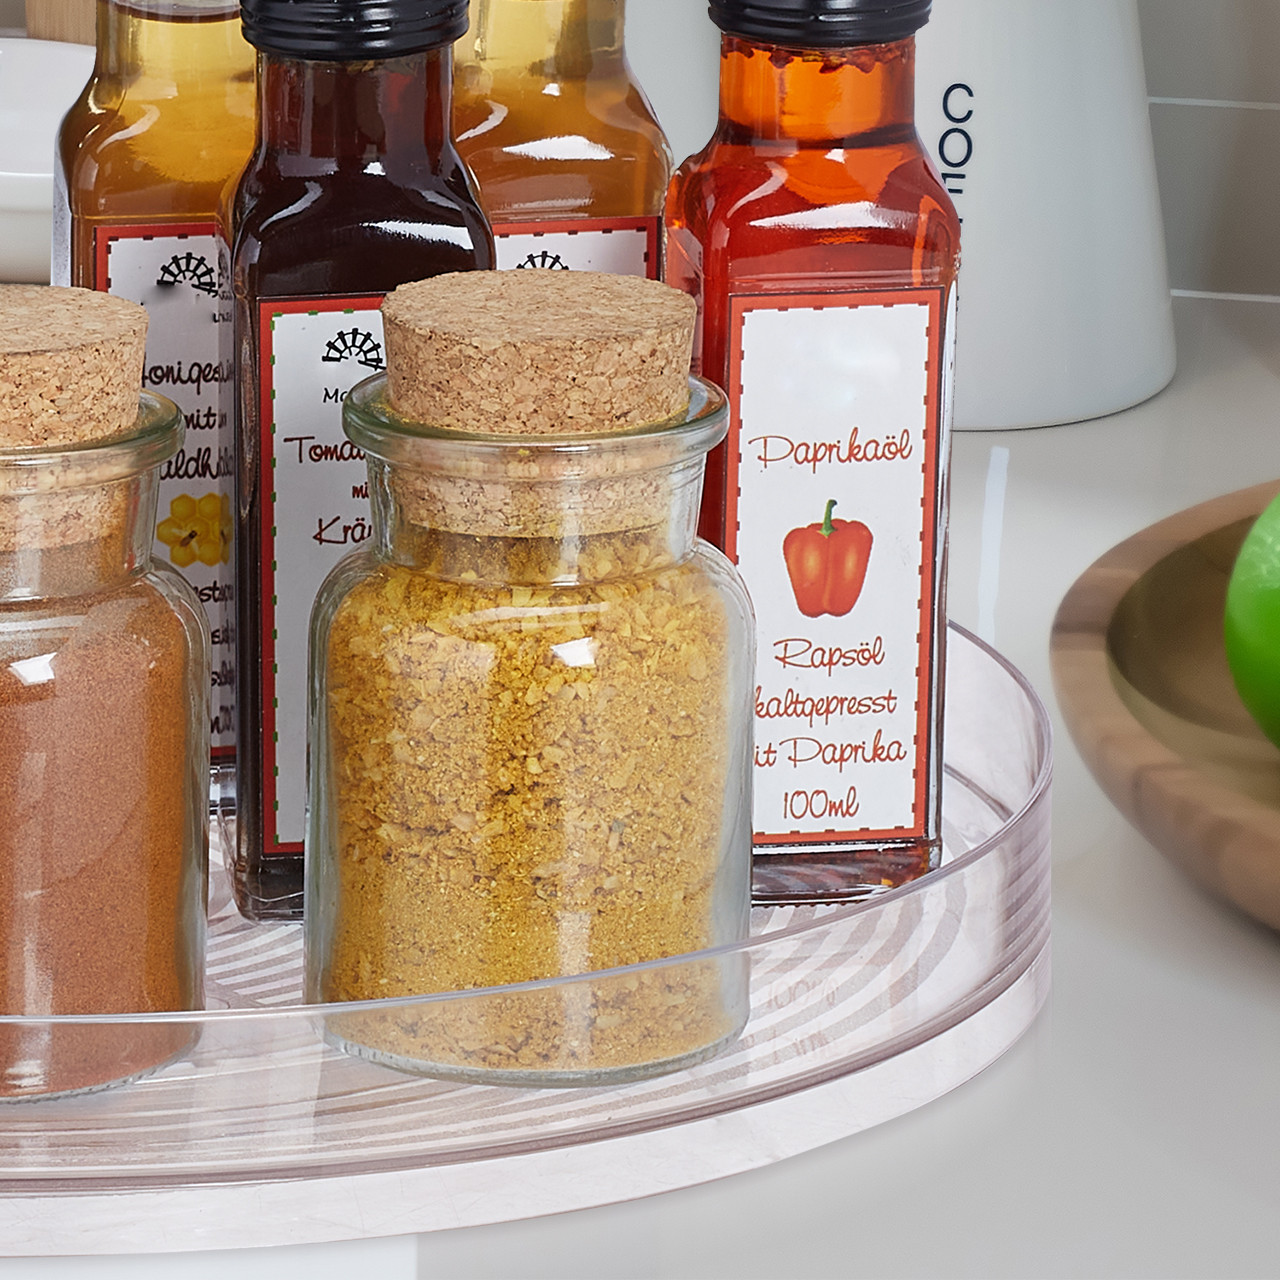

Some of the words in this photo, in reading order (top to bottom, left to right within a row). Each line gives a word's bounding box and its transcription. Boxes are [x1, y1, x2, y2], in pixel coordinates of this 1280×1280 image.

[748, 426, 912, 474] Paprikaöl
[773, 635, 885, 677] Rapsöl
[755, 685, 897, 728] kaltgepresst
[754, 742, 777, 767] it
[779, 728, 907, 773] Paprika
[783, 785, 859, 819] 100ml
